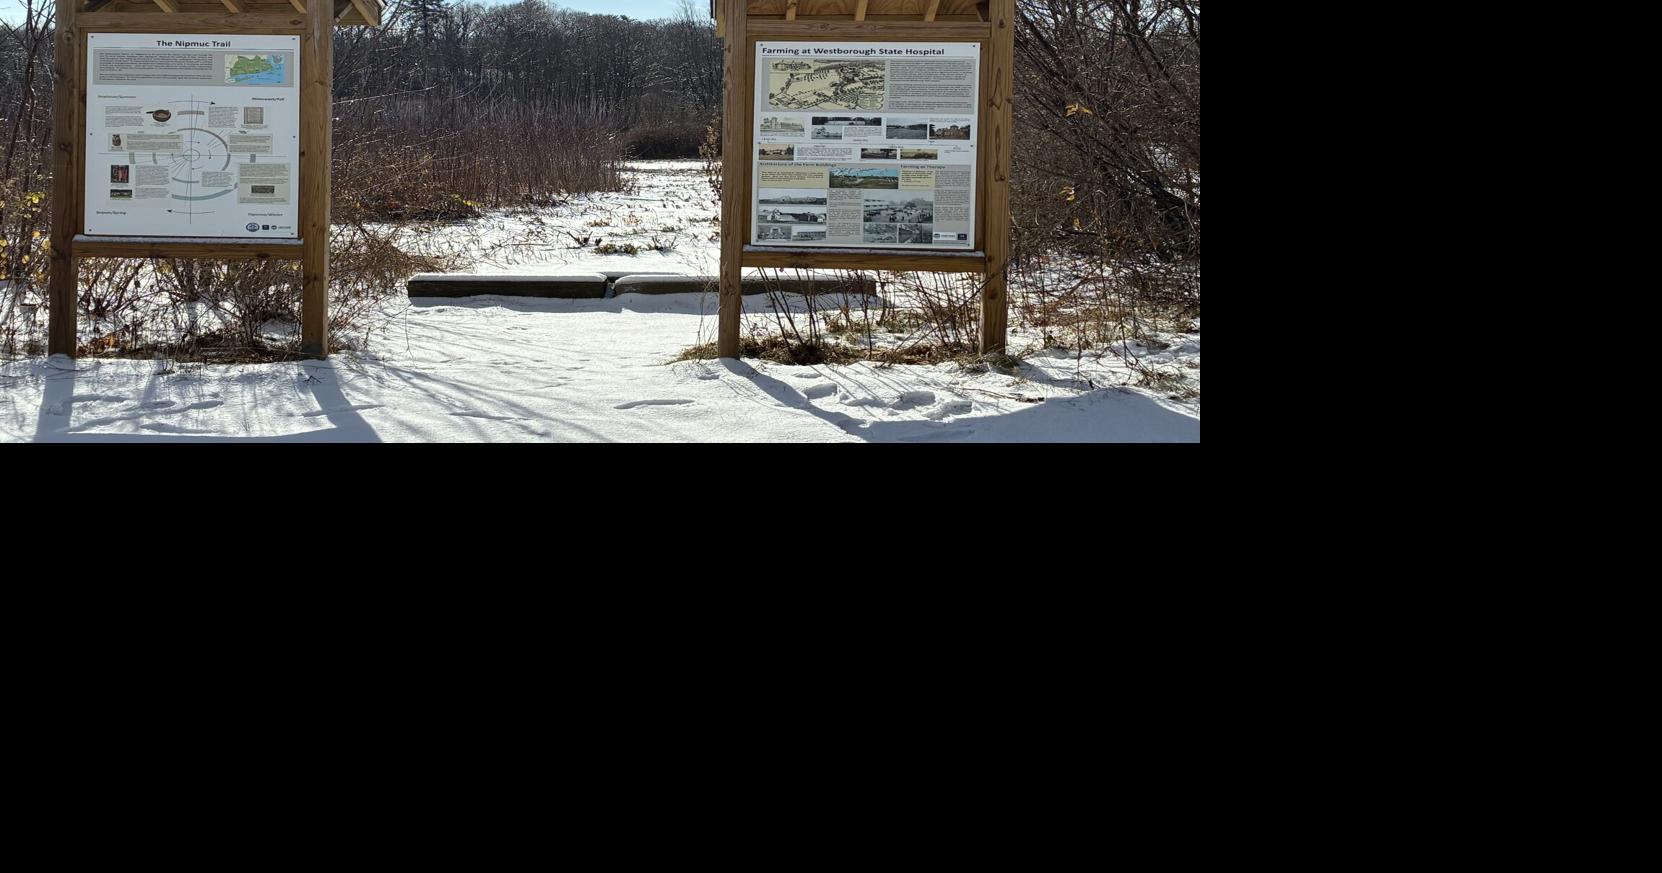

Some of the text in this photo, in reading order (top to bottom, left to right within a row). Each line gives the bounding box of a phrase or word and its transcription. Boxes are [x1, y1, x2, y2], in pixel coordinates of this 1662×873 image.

[175, 40, 210, 48] Nipmuc
[762, 47, 800, 55] Farming
[813, 47, 877, 56] Westborough
[905, 48, 945, 56] Hospital
